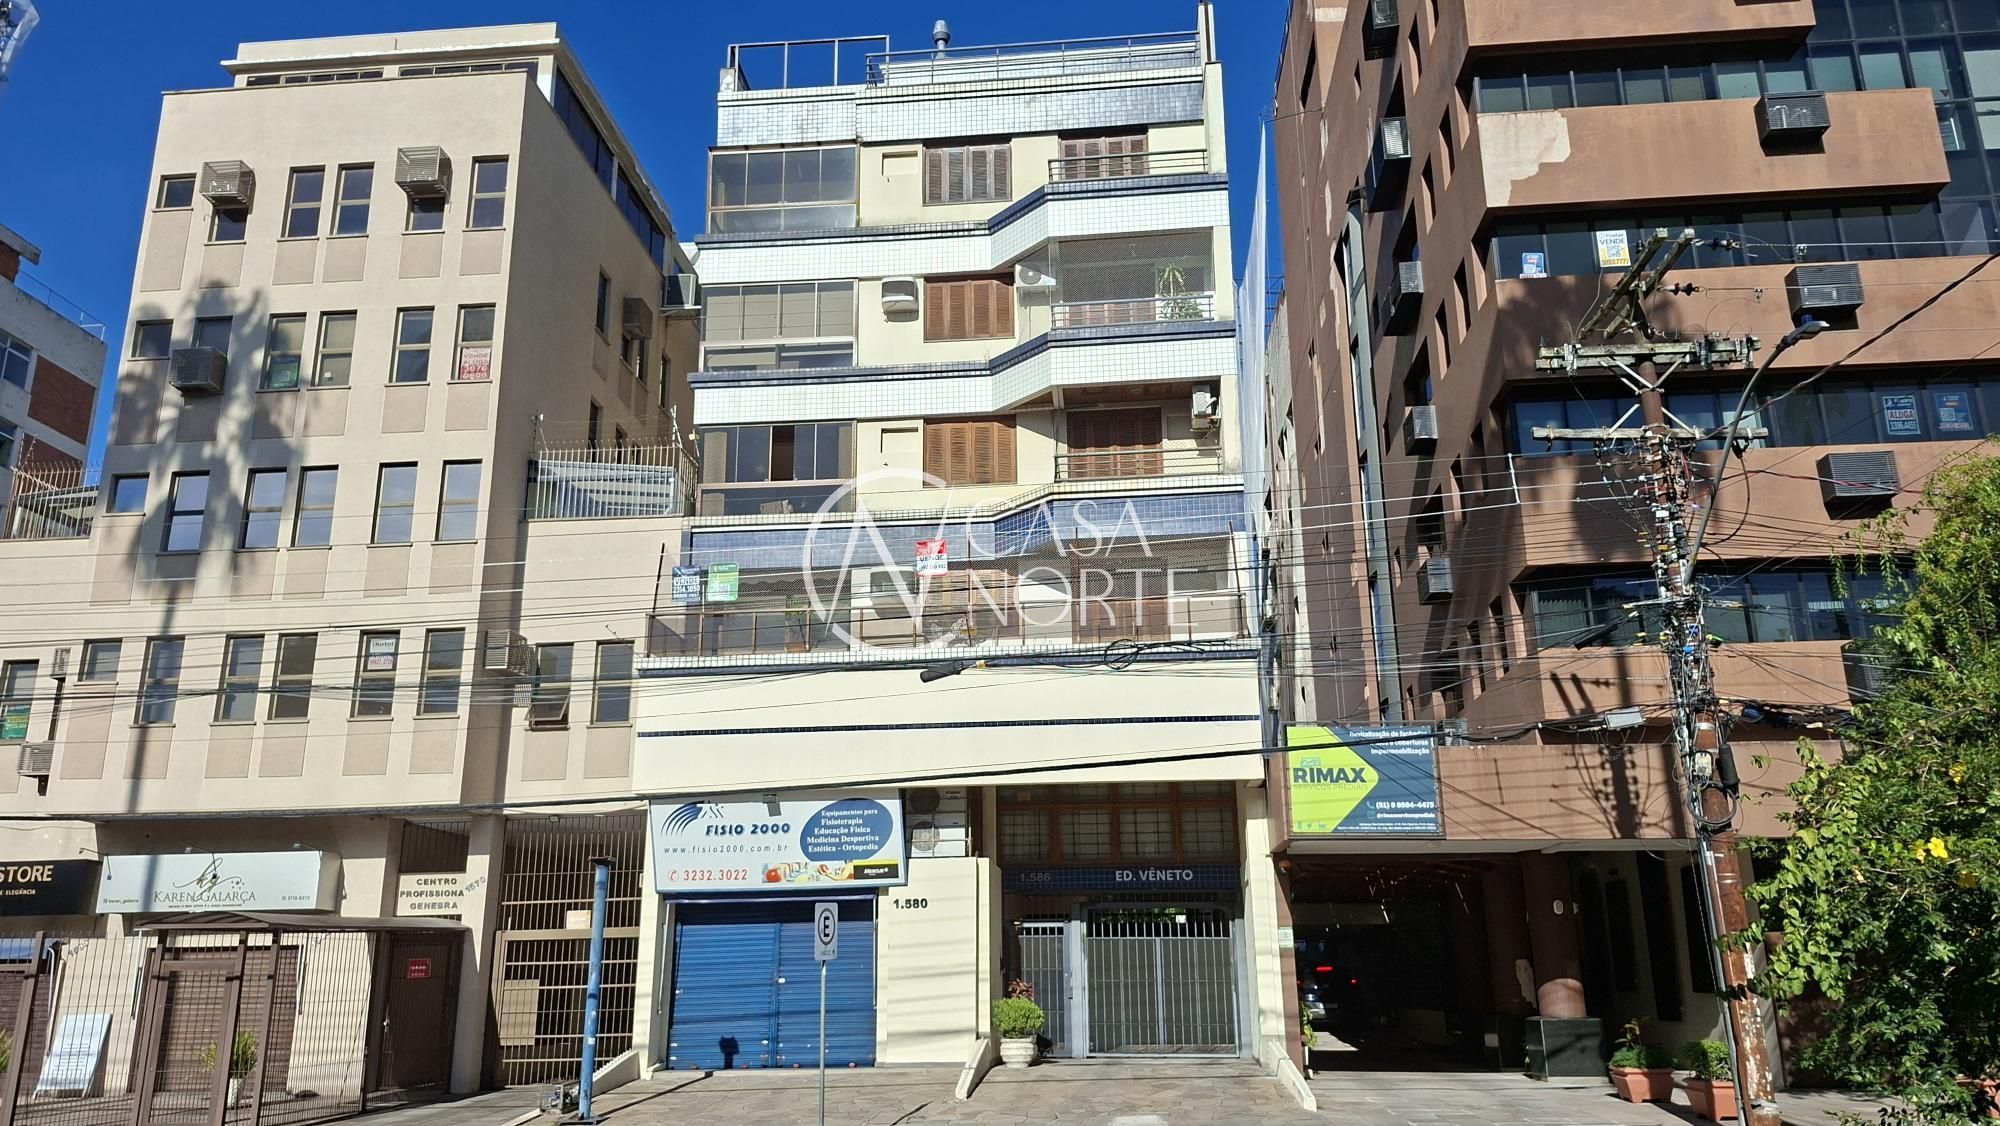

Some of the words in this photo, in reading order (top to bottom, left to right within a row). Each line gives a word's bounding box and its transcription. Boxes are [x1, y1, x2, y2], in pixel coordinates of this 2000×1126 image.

[1889, 410, 1916, 419] ALUGA
[675, 576, 699, 585] VENDE
[1293, 767, 1367, 783] RIMAX
[1375, 801, 1390, 809] (51)
[821, 810, 863, 818] Equipamentos
[821, 817, 863, 826] Fisioterapia
[705, 824, 745, 836] FISIO
[750, 823, 791, 835] 2000
[814, 826, 849, 835] Educação
[807, 836, 840, 844] Medicina
[841, 835, 879, 844] Desportiva
[664, 844, 788, 854] www.fisio2000.com.br
[842, 844, 878, 852] Ortopedia
[0, 865, 54, 883] STORE
[684, 869, 748, 881] 3232.3022
[1019, 872, 1050, 882] 1.586
[1115, 870, 1137, 881] ED.
[1138, 867, 1193, 881] VÊNETO
[416, 877, 458, 886] CENTRO
[5, 888, 36, 896] ELEGÂNCIA
[399, 889, 465, 898] PROFISSIONA
[154, 891, 196, 902] KAREN
[201, 891, 257, 904] GALARÇA
[409, 901, 458, 910] GENEBRA
[893, 898, 928, 909] 1.580
[823, 916, 830, 938] E
